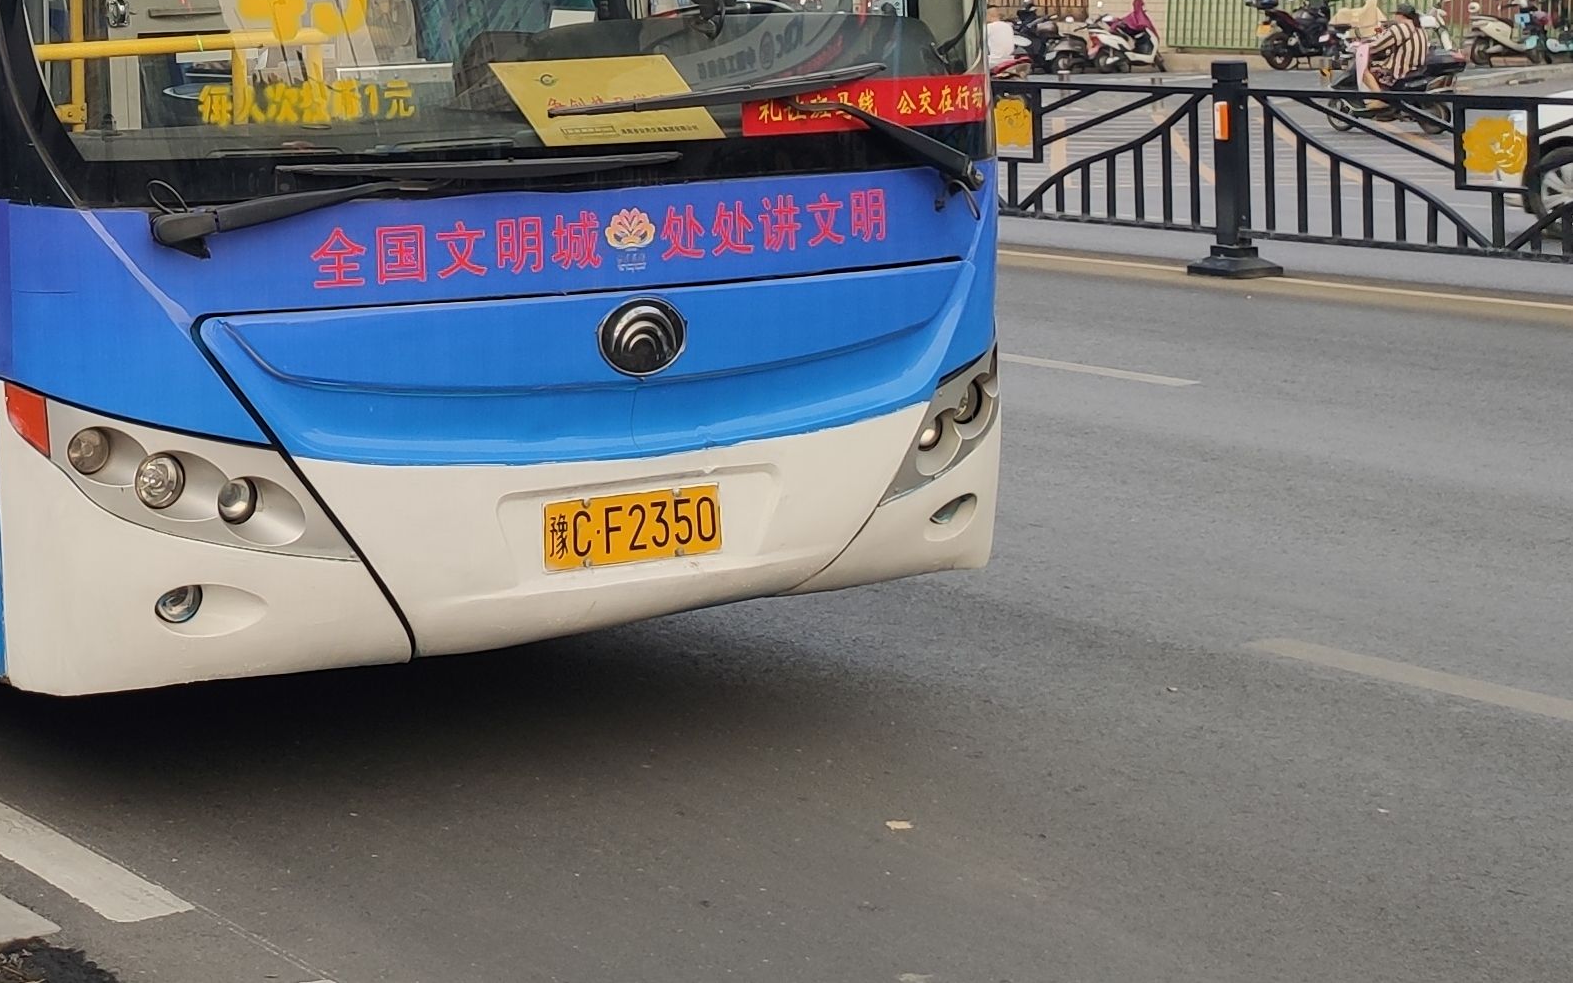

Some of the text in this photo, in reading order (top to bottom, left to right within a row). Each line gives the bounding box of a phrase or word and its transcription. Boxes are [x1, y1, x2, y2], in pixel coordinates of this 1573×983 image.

[896, 84, 983, 116] 公交在行动
[310, 188, 888, 290] 全国文明城 处处讲文明
